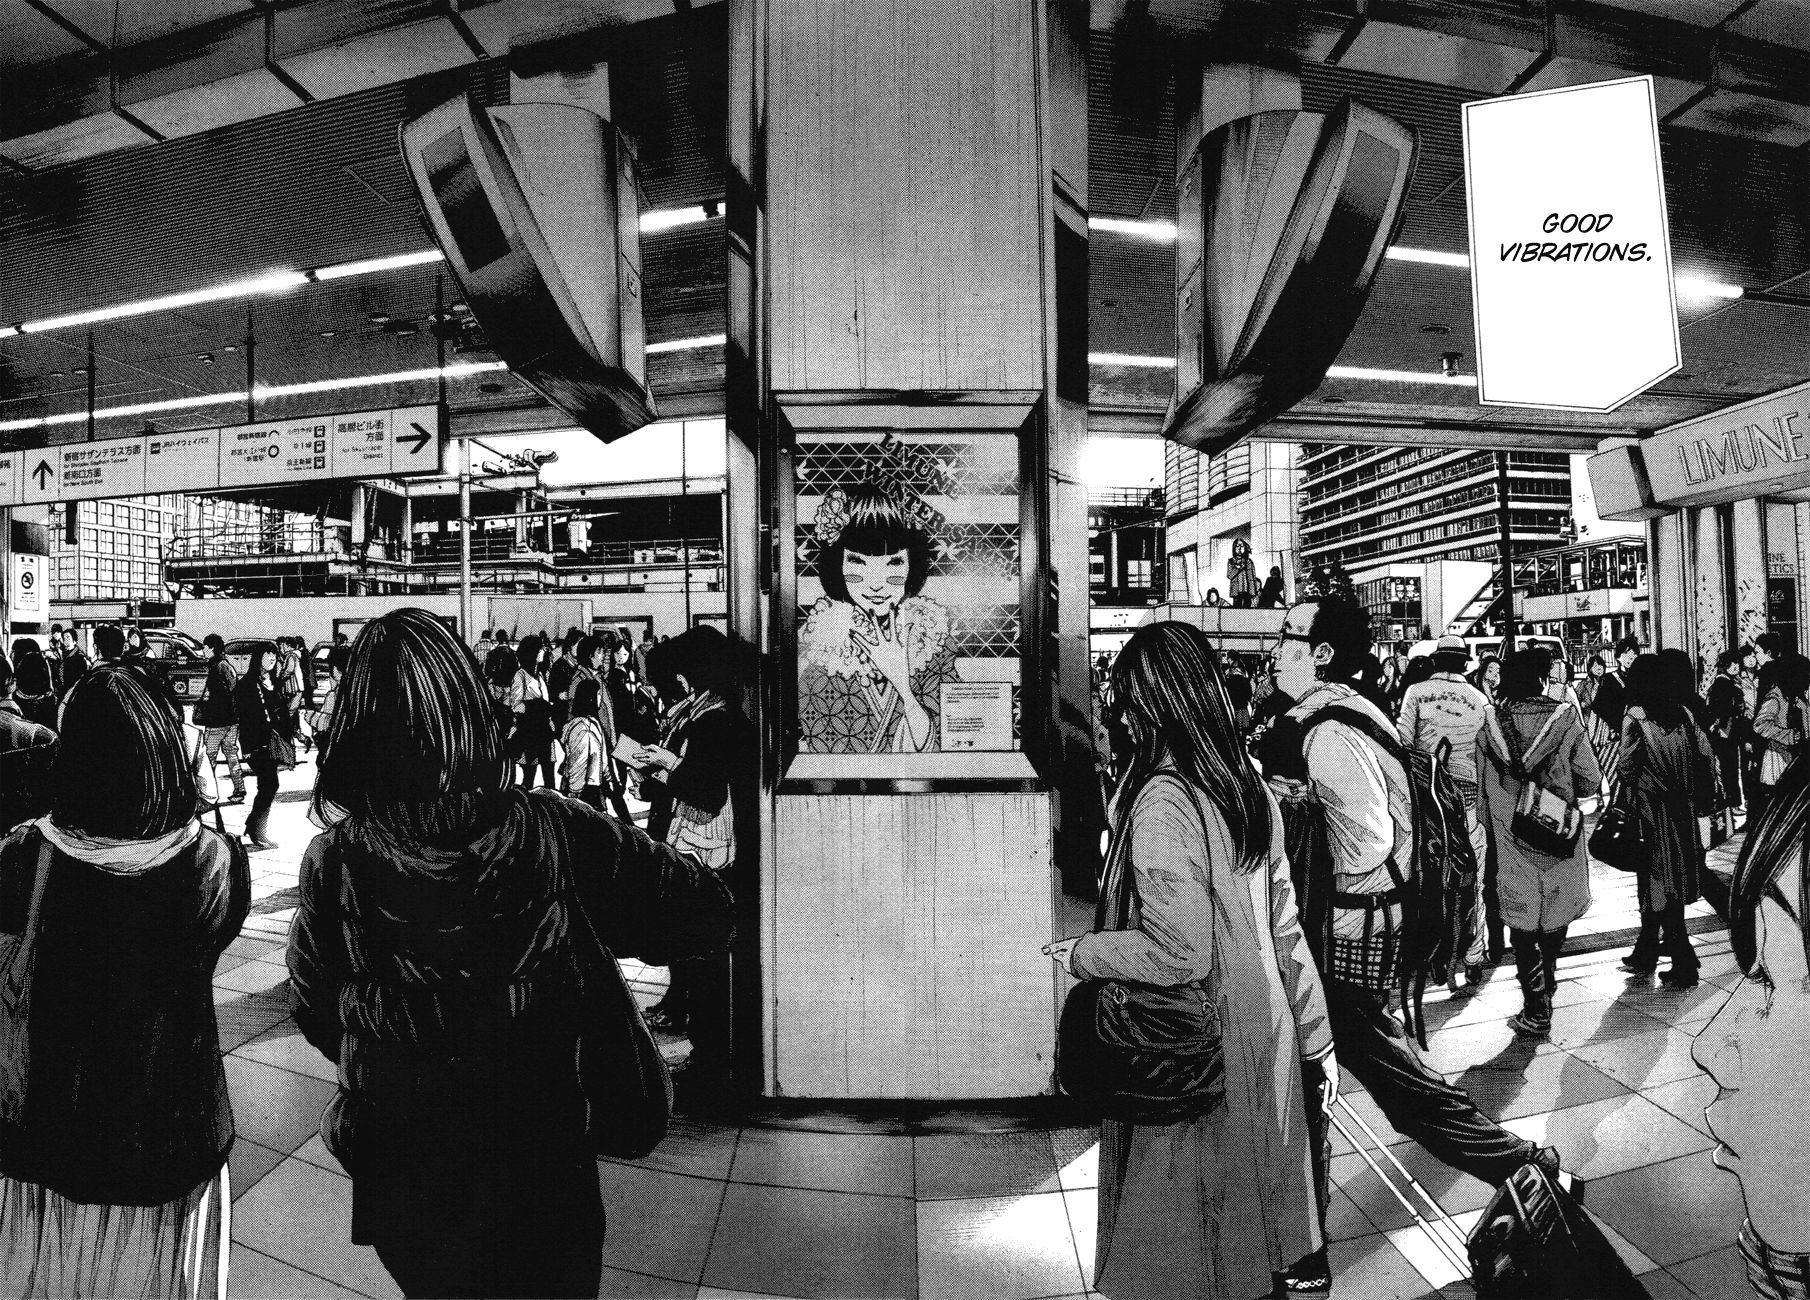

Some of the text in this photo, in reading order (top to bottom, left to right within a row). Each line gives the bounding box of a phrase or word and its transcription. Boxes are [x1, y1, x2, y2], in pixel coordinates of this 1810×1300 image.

[338, 419, 384, 433] 高層ビル街
[365, 431, 384, 442] 方面
[64, 444, 141, 462] 新宿サザンテラス方面
[1678, 411, 1810, 486] LIMUNE
